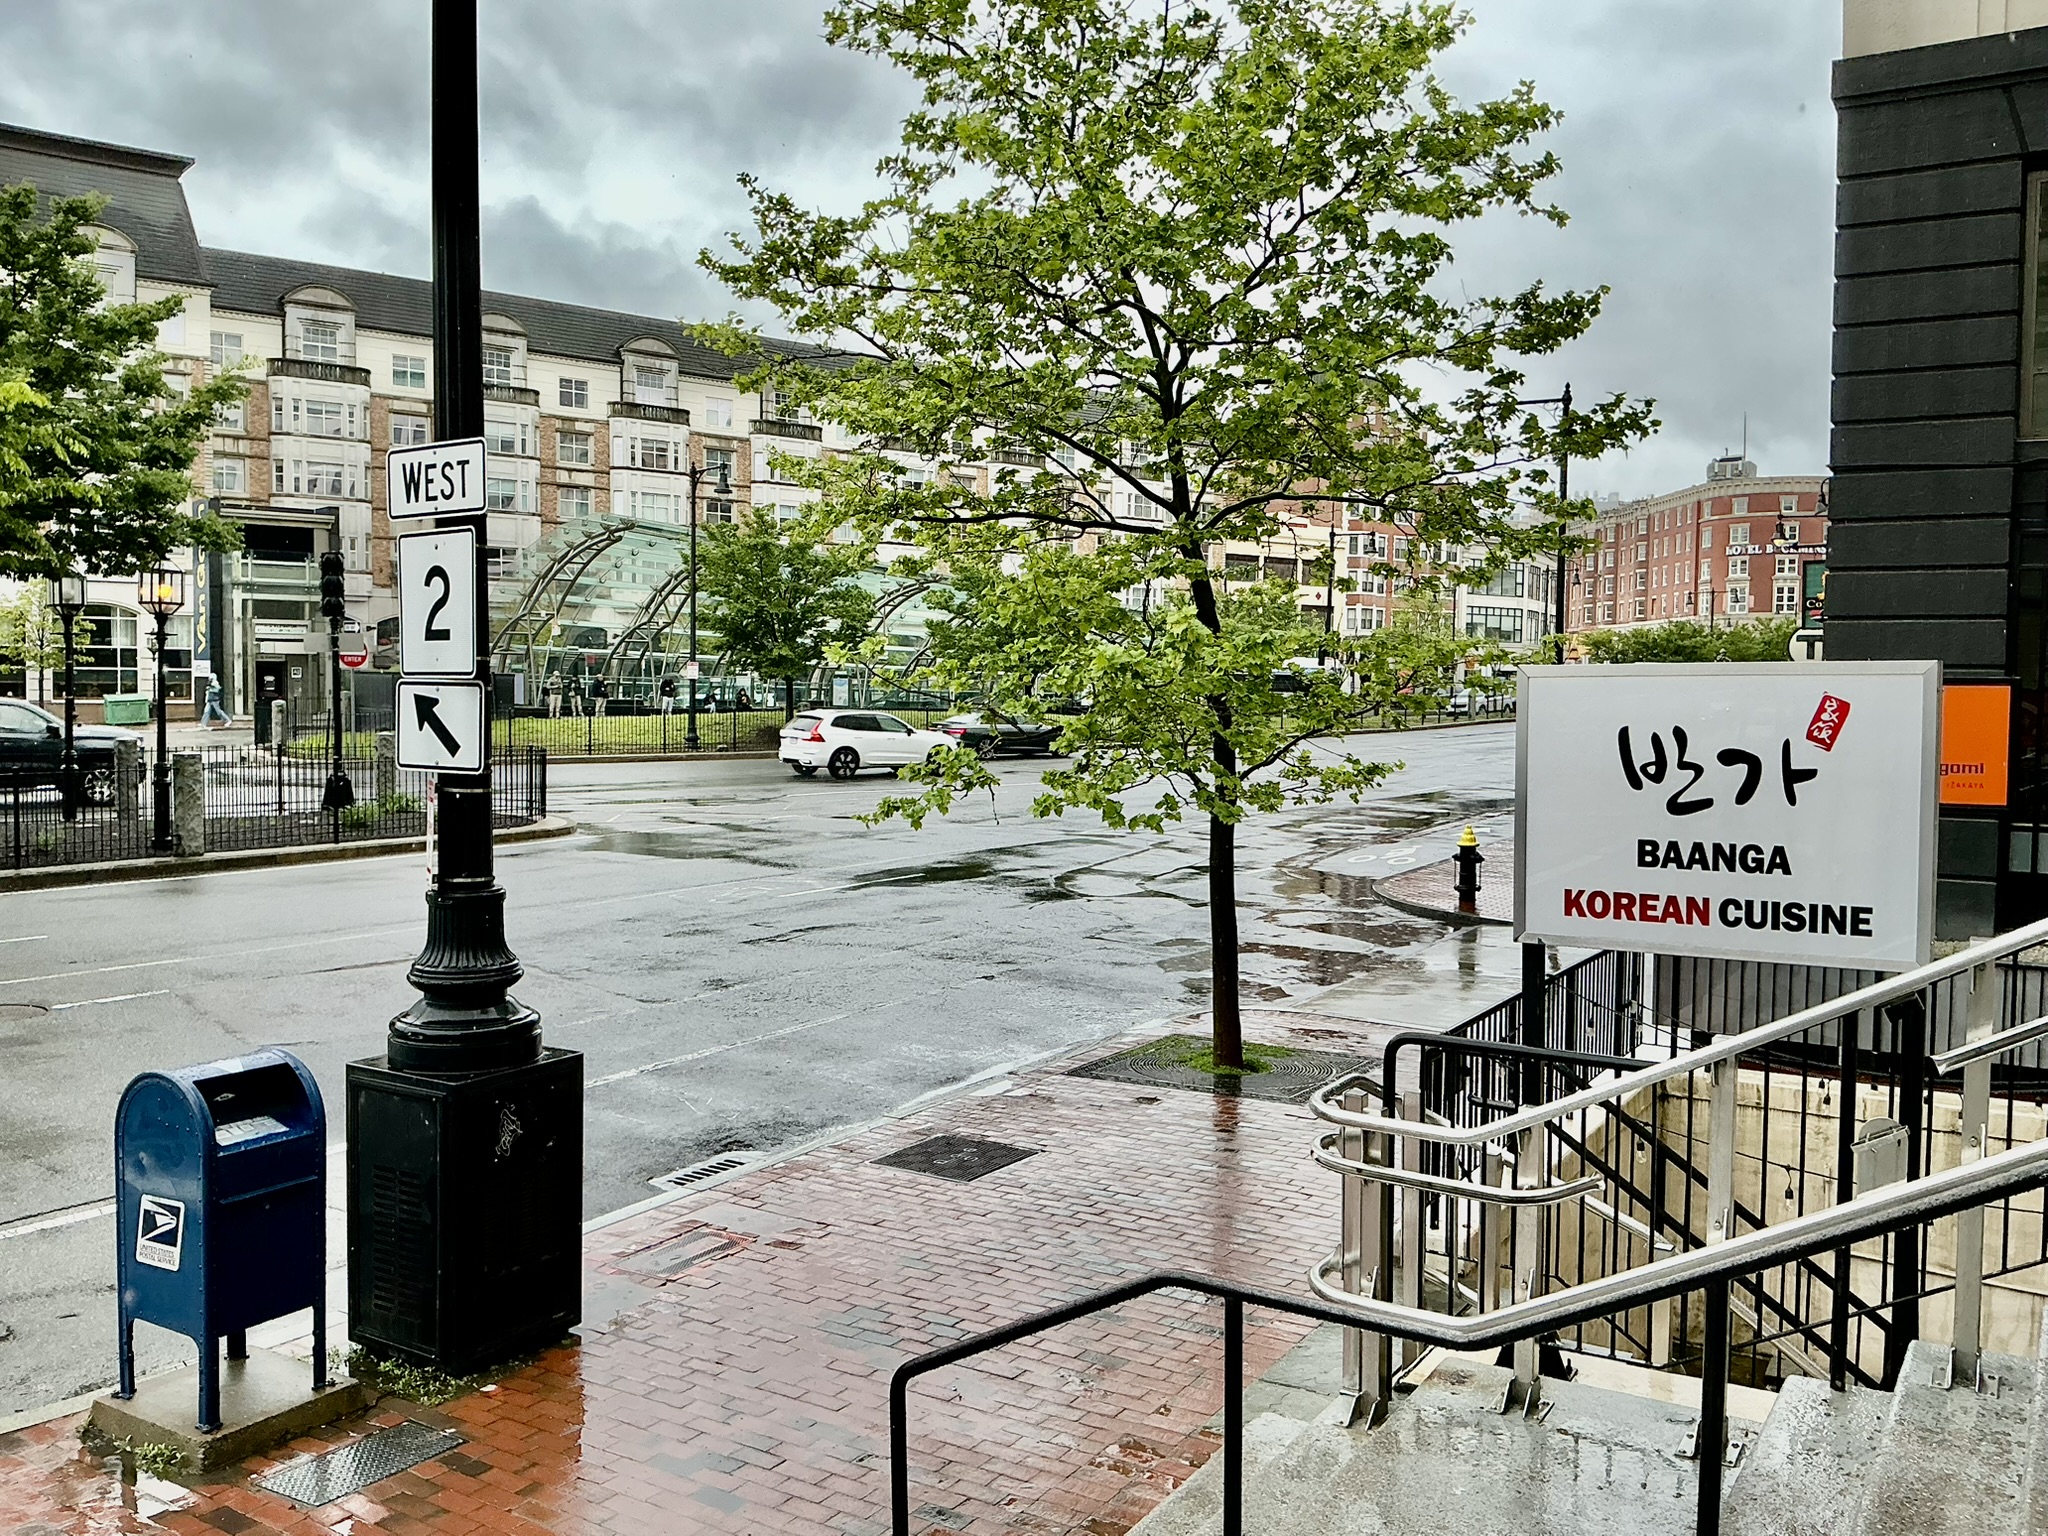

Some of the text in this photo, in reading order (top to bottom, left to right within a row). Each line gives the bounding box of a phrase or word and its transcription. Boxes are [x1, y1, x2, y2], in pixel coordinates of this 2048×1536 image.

[402, 459, 470, 504] WEST
[424, 564, 451, 642] 2
[343, 655, 362, 663] ENTER
[1637, 838, 1792, 876] BAANGA
[1563, 888, 1874, 937] KOREAN CUISINE
[139, 1252, 176, 1267] POSTAL SERVICE
[140, 1244, 157, 1254] UNITED
